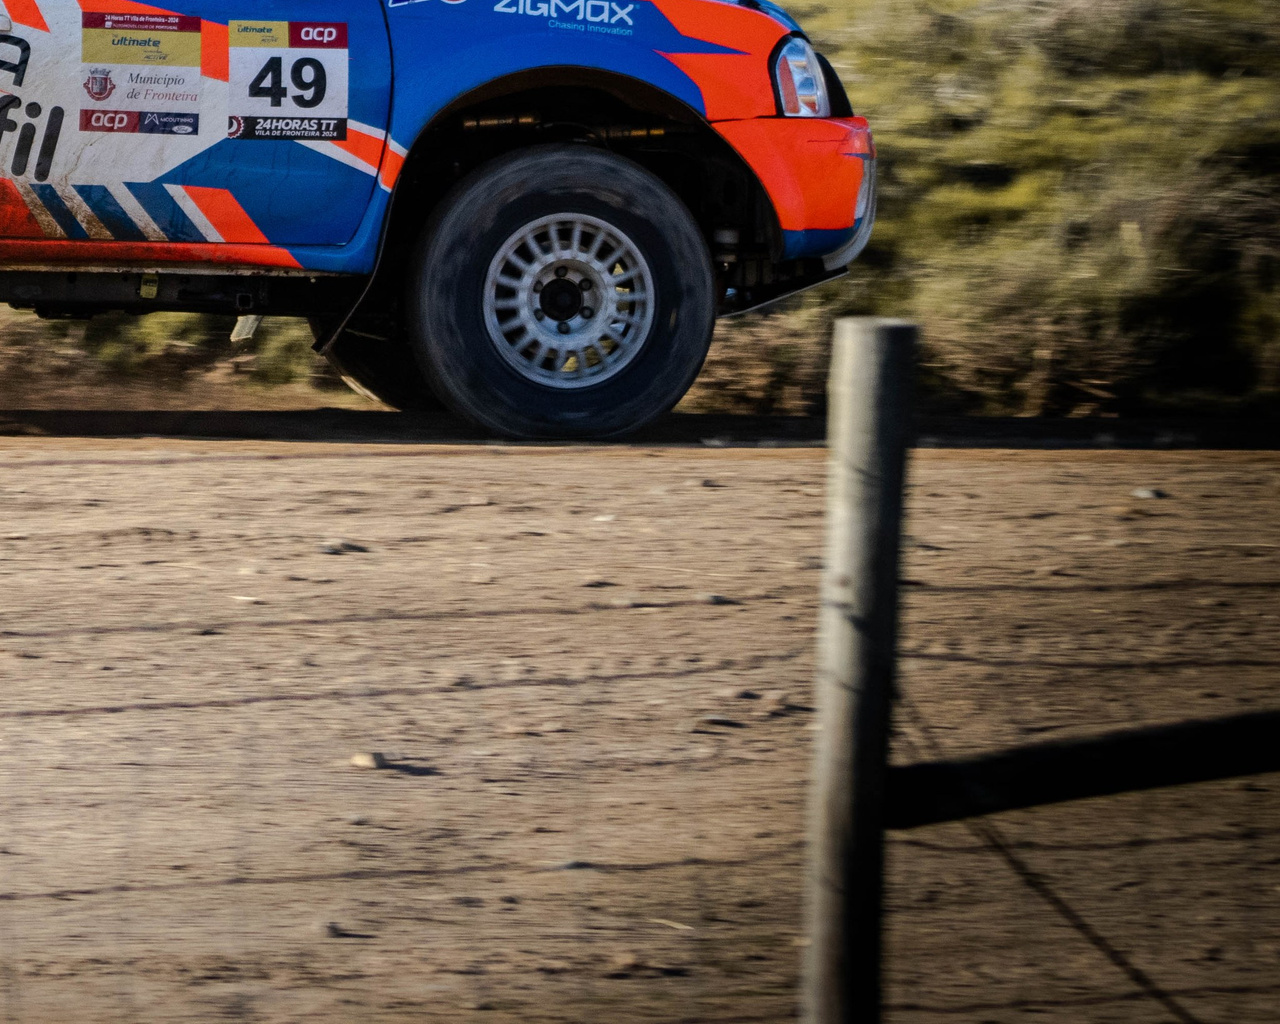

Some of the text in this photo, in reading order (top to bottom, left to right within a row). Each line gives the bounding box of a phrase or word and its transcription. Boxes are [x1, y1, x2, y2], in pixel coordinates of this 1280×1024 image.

[300, 27, 337, 43] acp
[548, 19, 633, 36] Chasing Innovation
[112, 36, 160, 47] ultimate
[128, 73, 185, 88] Município
[248, 56, 327, 108] 49
[126, 88, 198, 101] de Fronteira
[91, 113, 128, 129] acp
[320, 120, 337, 130] TT
